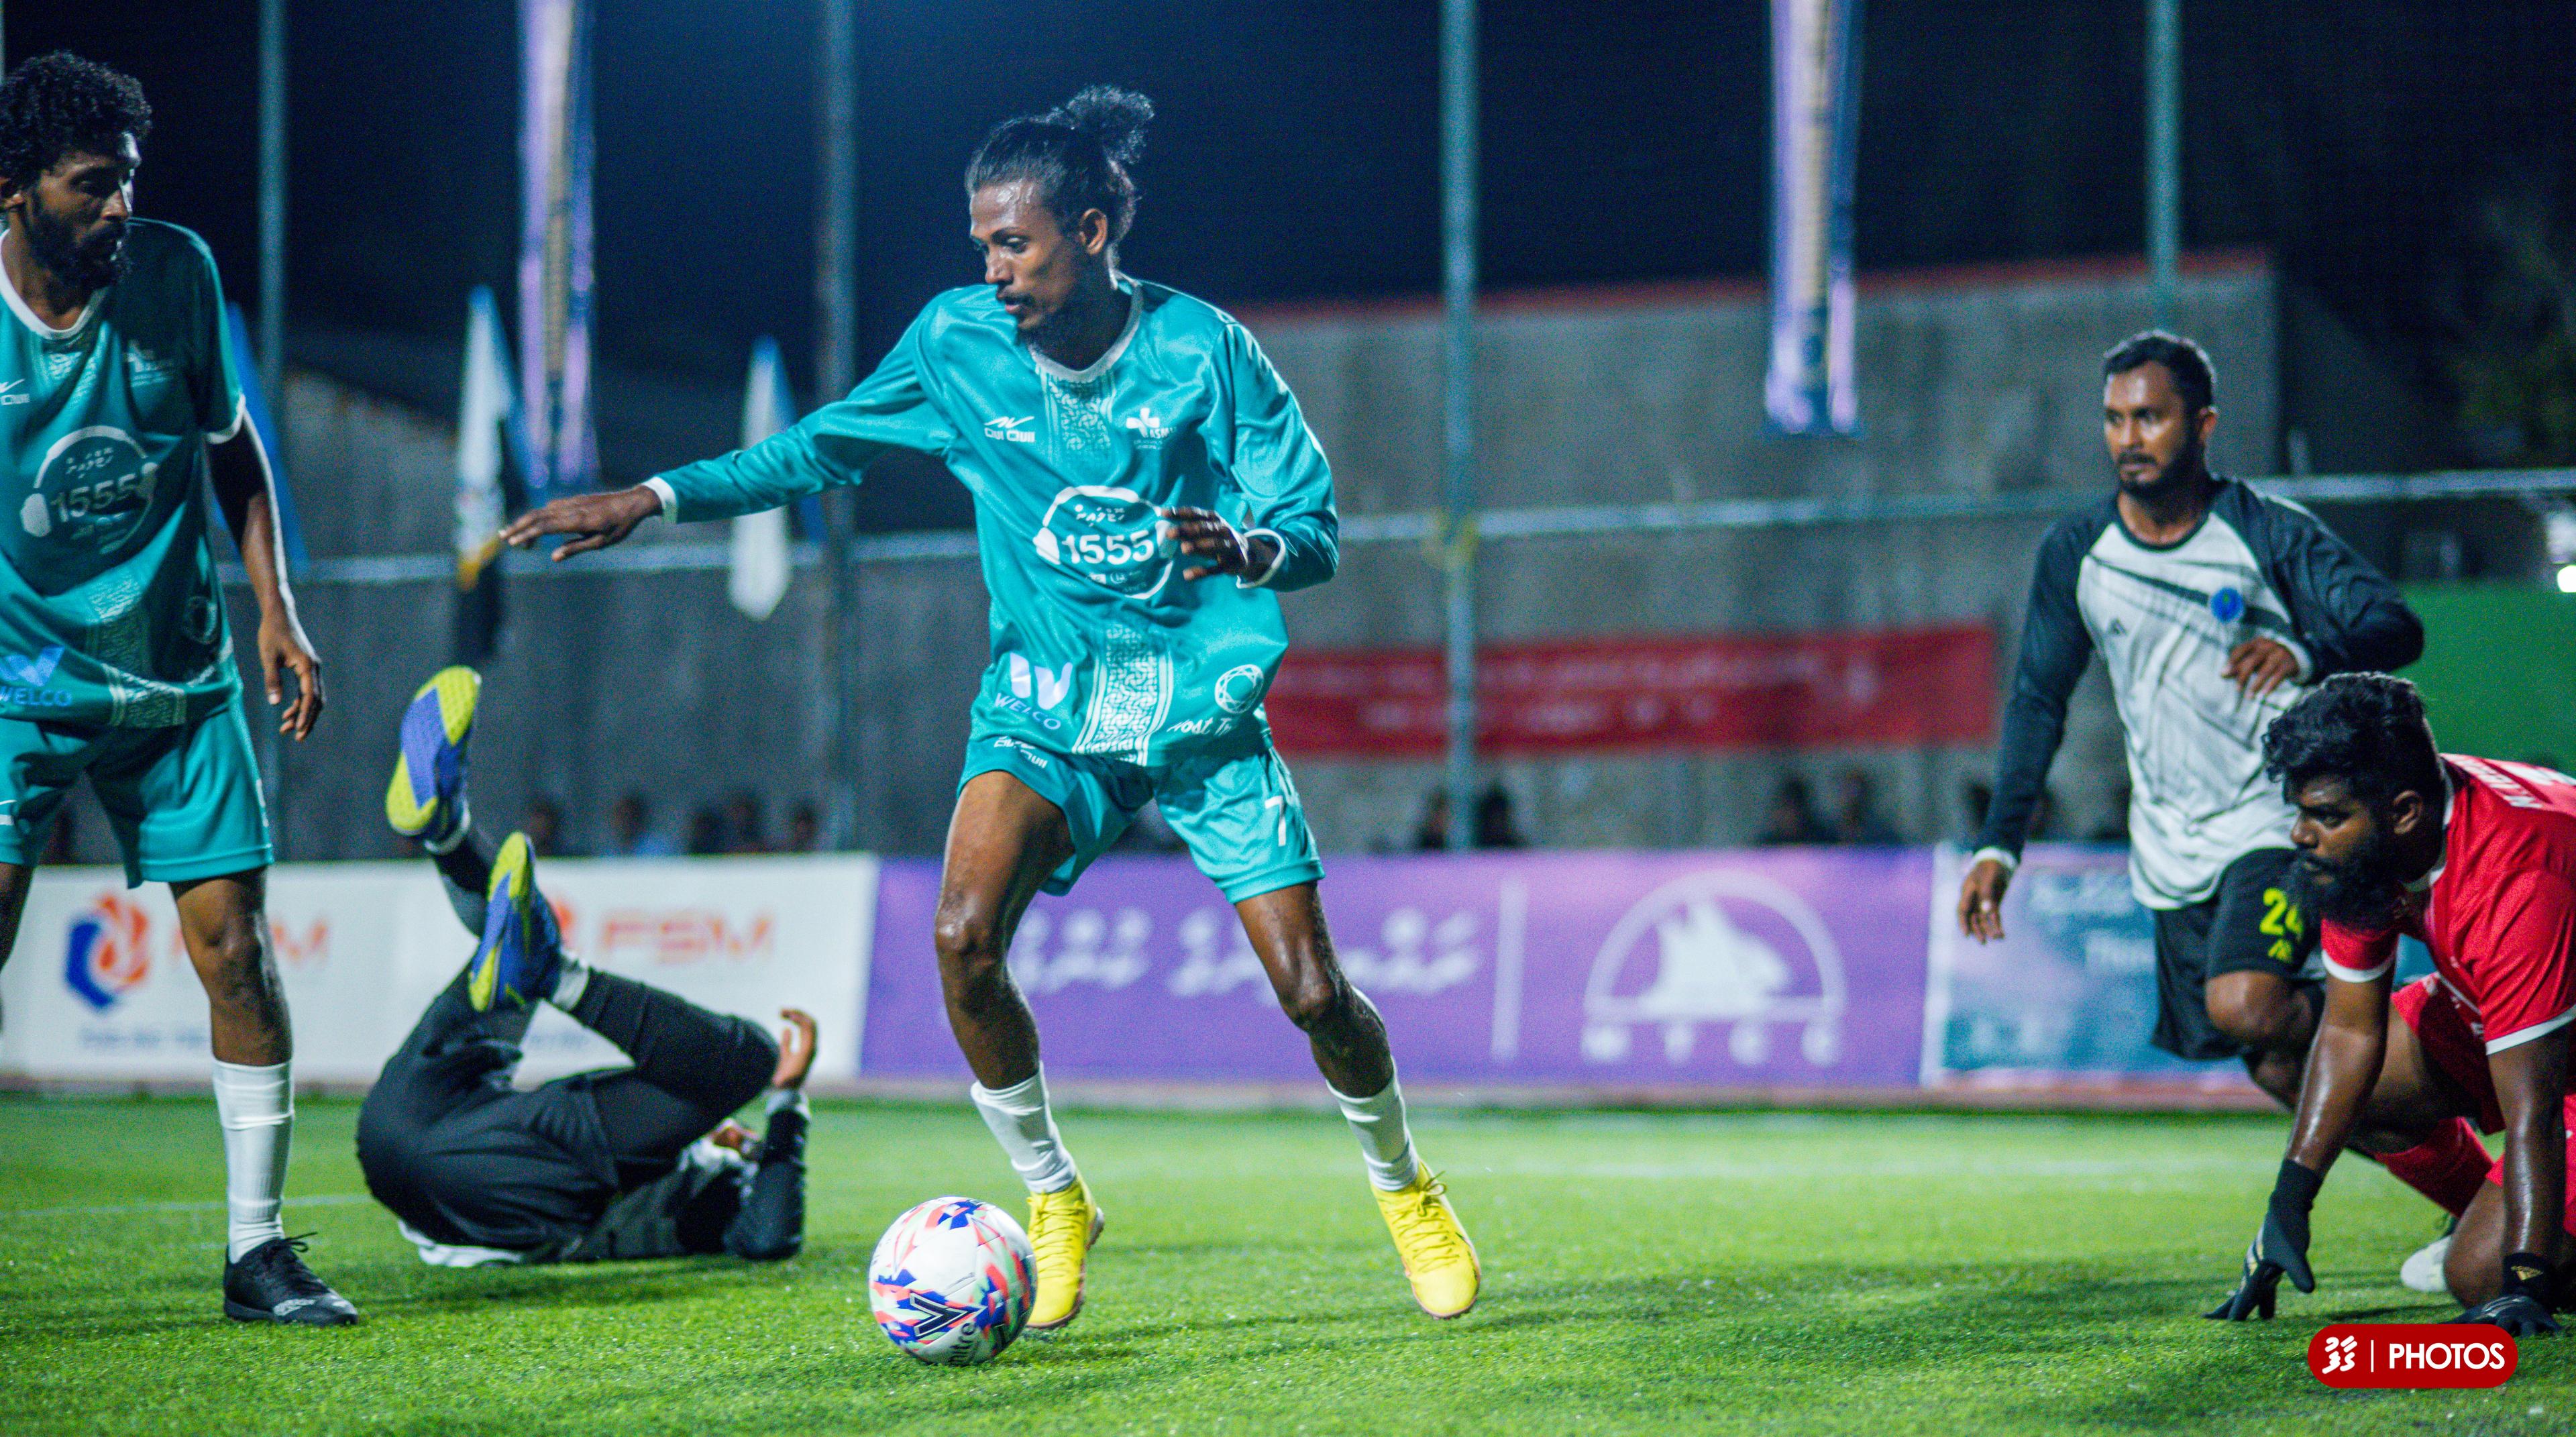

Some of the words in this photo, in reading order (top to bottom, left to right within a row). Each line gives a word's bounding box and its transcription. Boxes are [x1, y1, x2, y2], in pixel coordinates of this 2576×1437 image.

[1061, 530, 1155, 565] 1555
[994, 692, 1061, 730] WELCO
[1265, 795, 1287, 847] 7
[2260, 887, 2304, 942] 24
